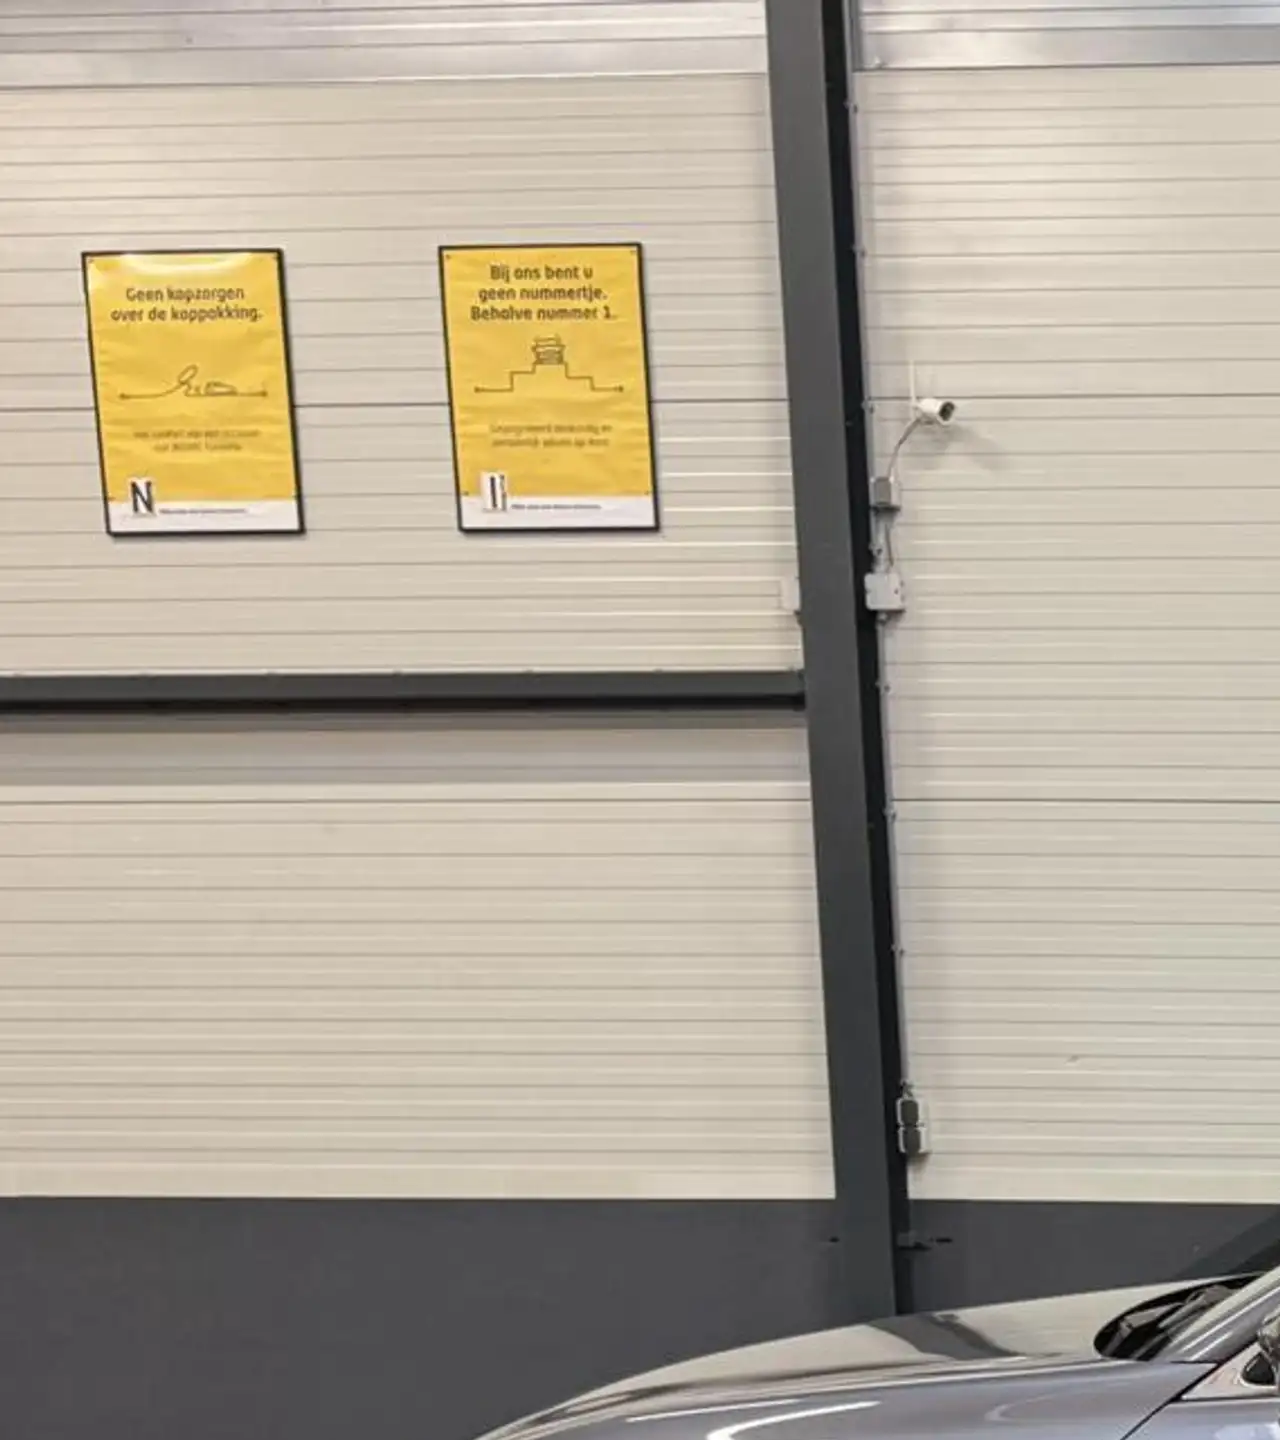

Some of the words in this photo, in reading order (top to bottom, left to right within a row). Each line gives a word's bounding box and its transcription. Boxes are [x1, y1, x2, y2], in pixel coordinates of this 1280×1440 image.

[489, 264, 510, 284] Bij
[514, 267, 541, 280] ons
[544, 264, 579, 280] bent
[583, 267, 593, 280] u
[126, 287, 163, 302] Geen
[167, 287, 245, 304] kopzorgen
[478, 288, 516, 303] geen
[519, 285, 608, 303] nummertje.
[111, 308, 143, 321] over
[148, 306, 167, 321] de
[171, 304, 263, 323] koppakking.
[470, 305, 533, 321] Behalve
[537, 307, 598, 321] nummer
[602, 305, 618, 320] 1.
